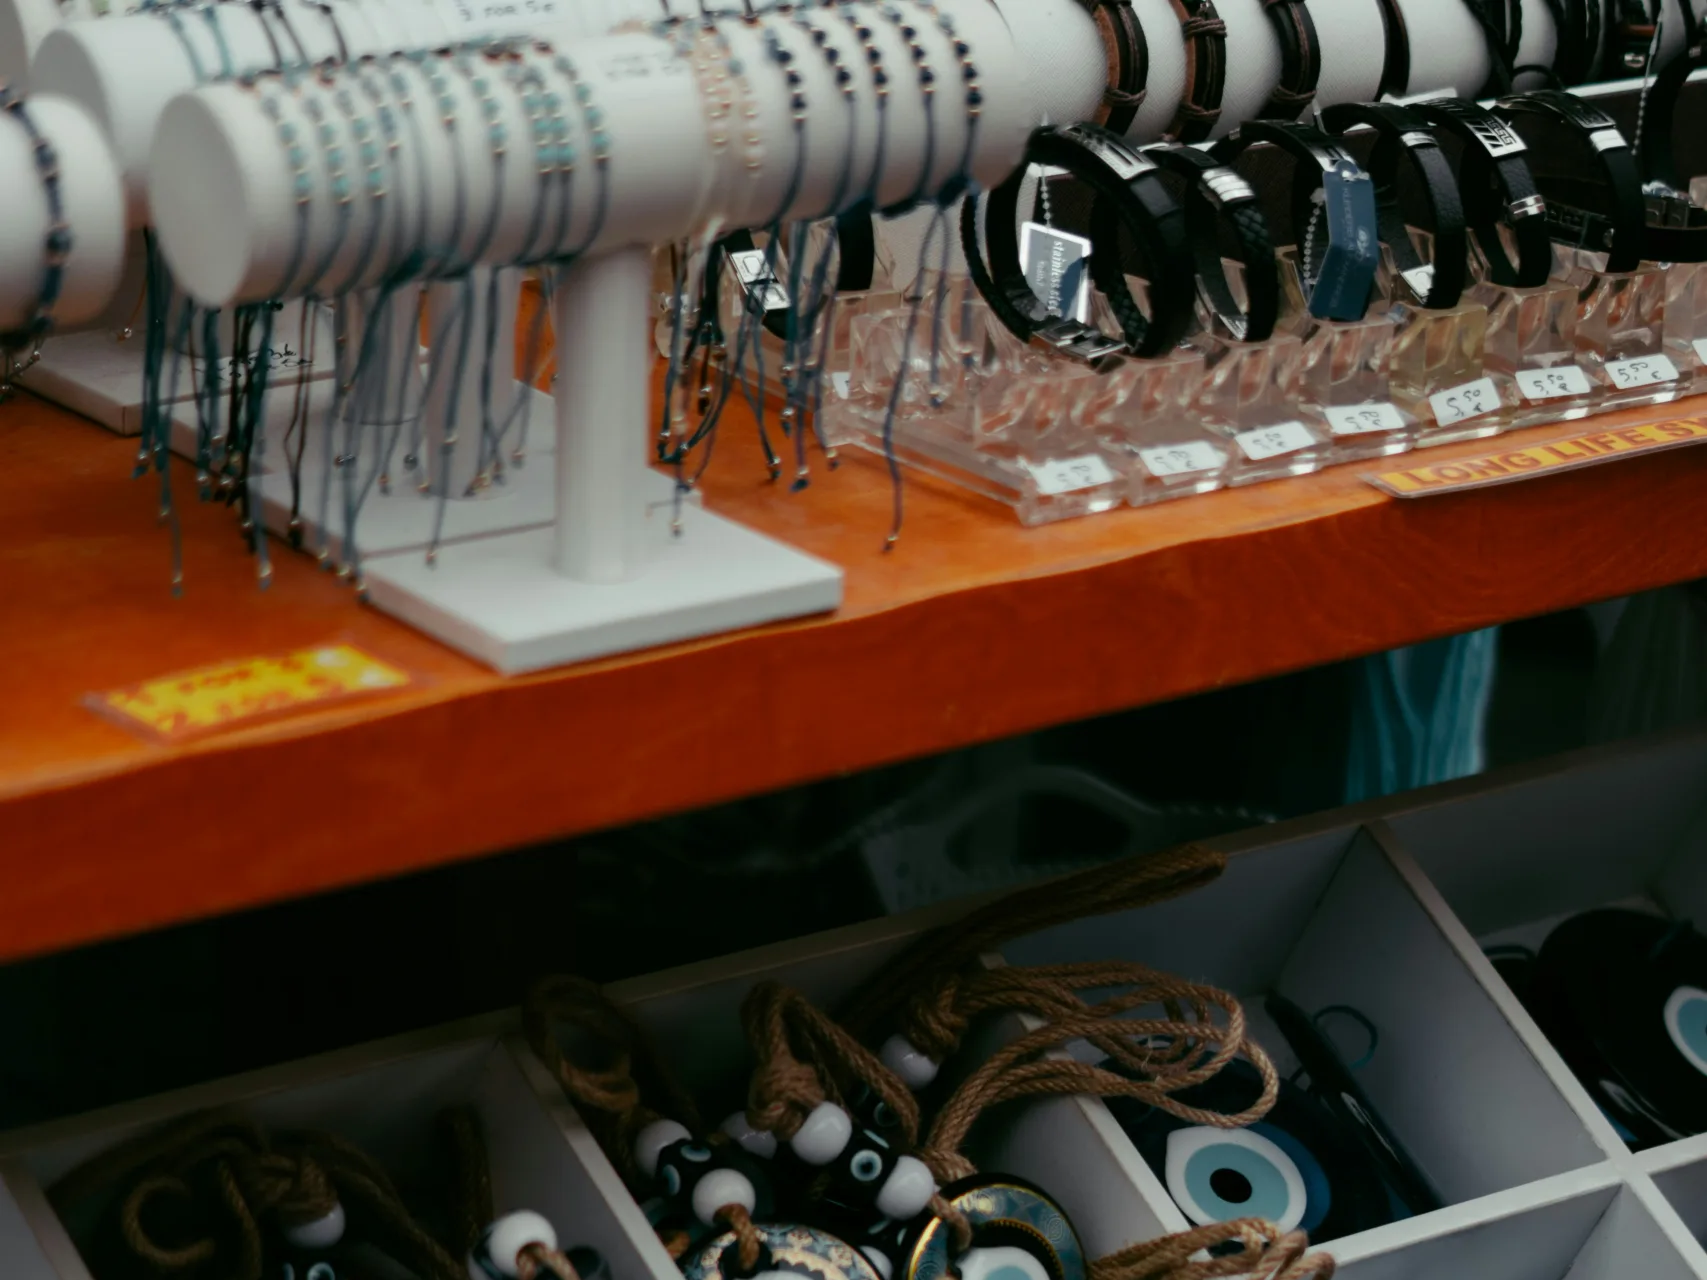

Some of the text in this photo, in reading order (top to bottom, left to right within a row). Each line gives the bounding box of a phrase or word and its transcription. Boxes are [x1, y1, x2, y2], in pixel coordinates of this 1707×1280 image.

[1050, 240, 1066, 289] stainless
[1400, 449, 1543, 489] LONG
[1548, 428, 1655, 462] LIFE
